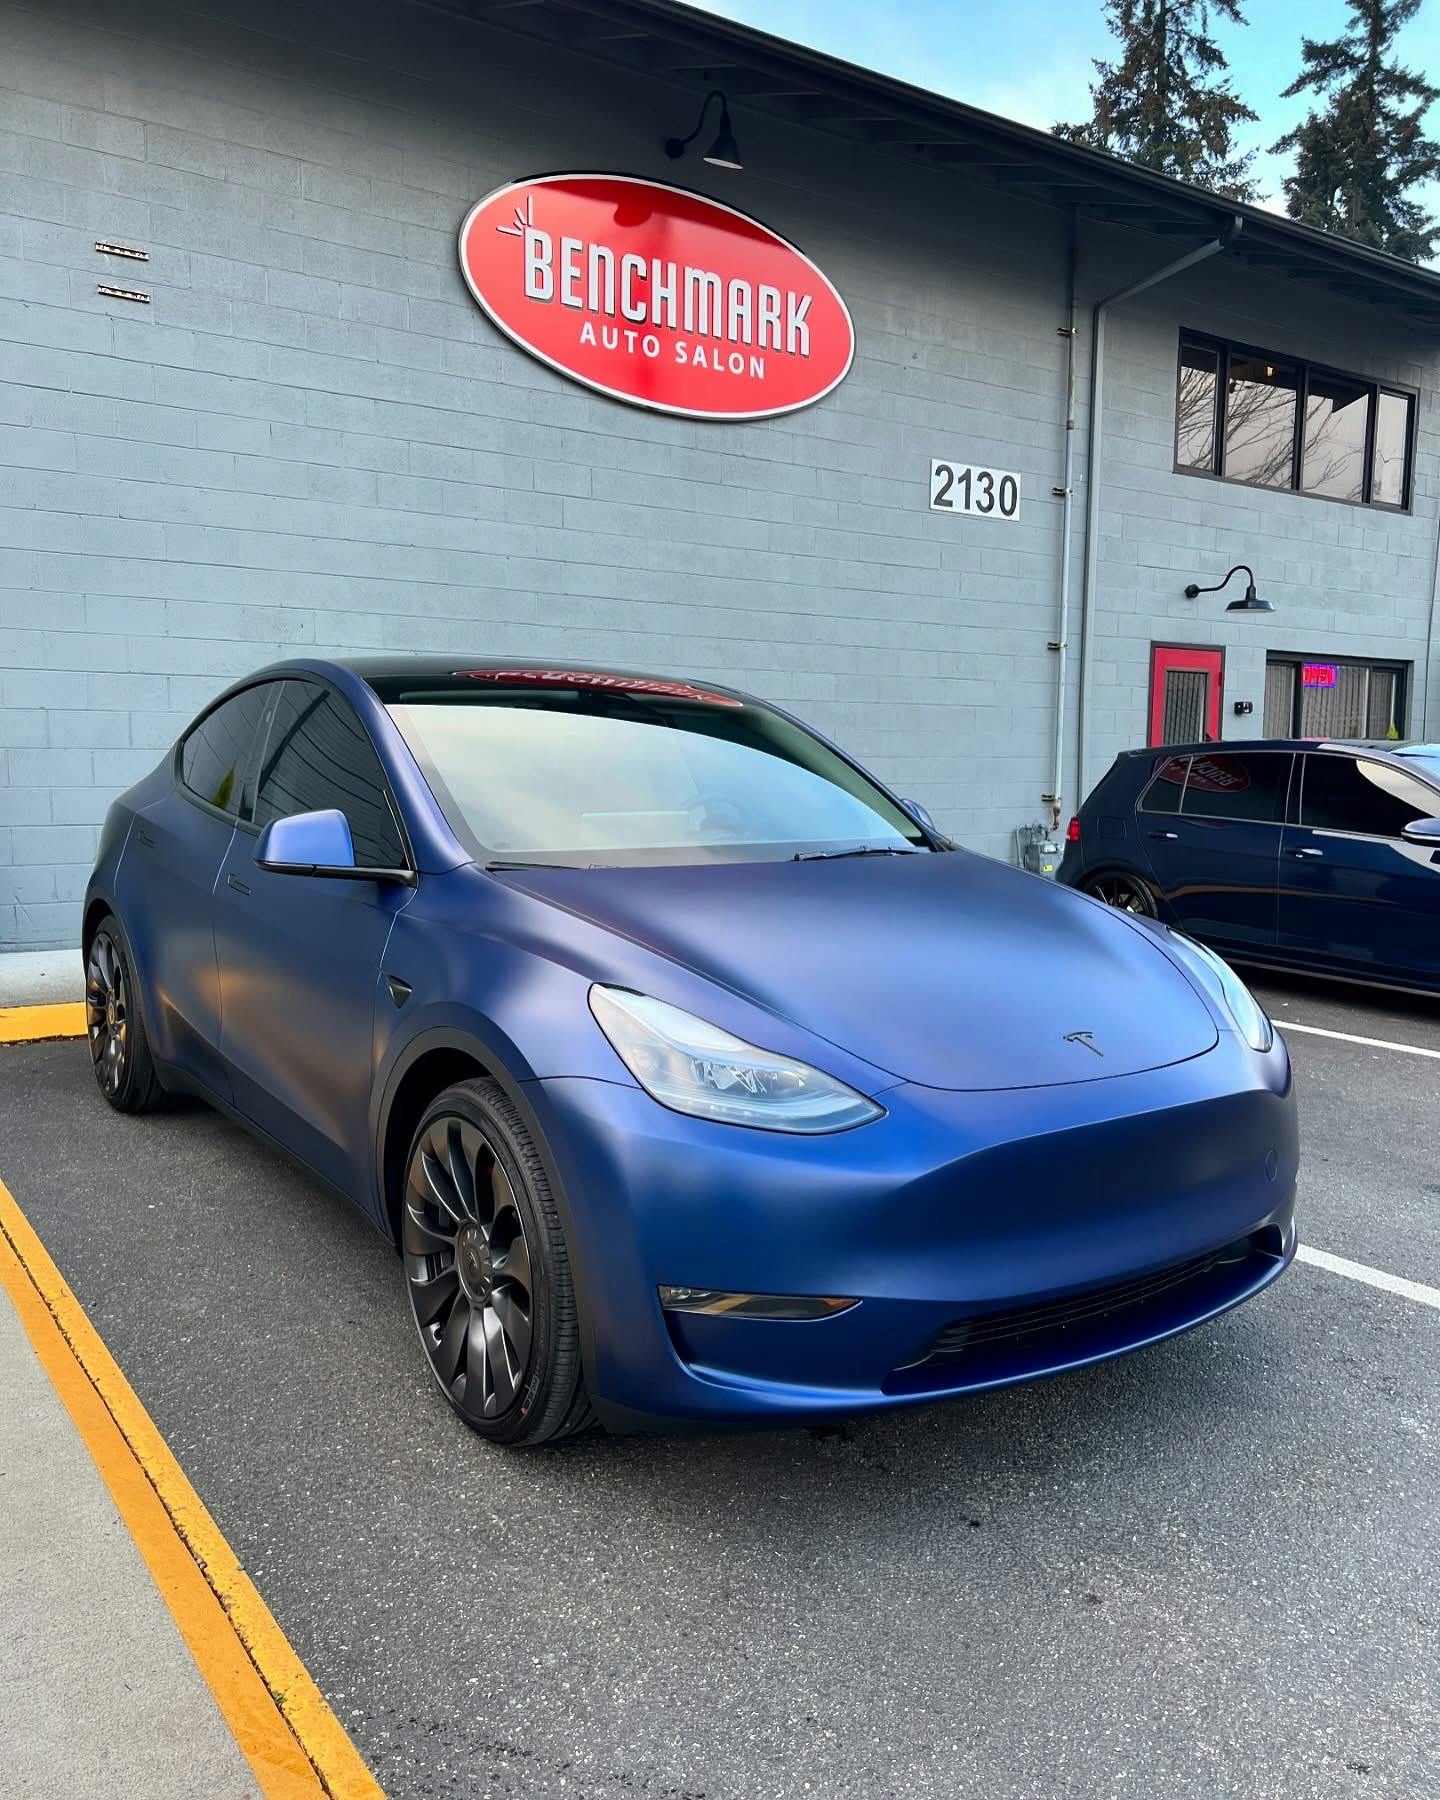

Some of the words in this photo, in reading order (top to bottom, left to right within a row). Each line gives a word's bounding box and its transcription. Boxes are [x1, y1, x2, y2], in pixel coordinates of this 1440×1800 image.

[523, 227, 812, 357] BENCHMARK
[580, 322, 660, 358] AUTO
[675, 341, 765, 379] SALON
[933, 464, 1018, 516] 2130
